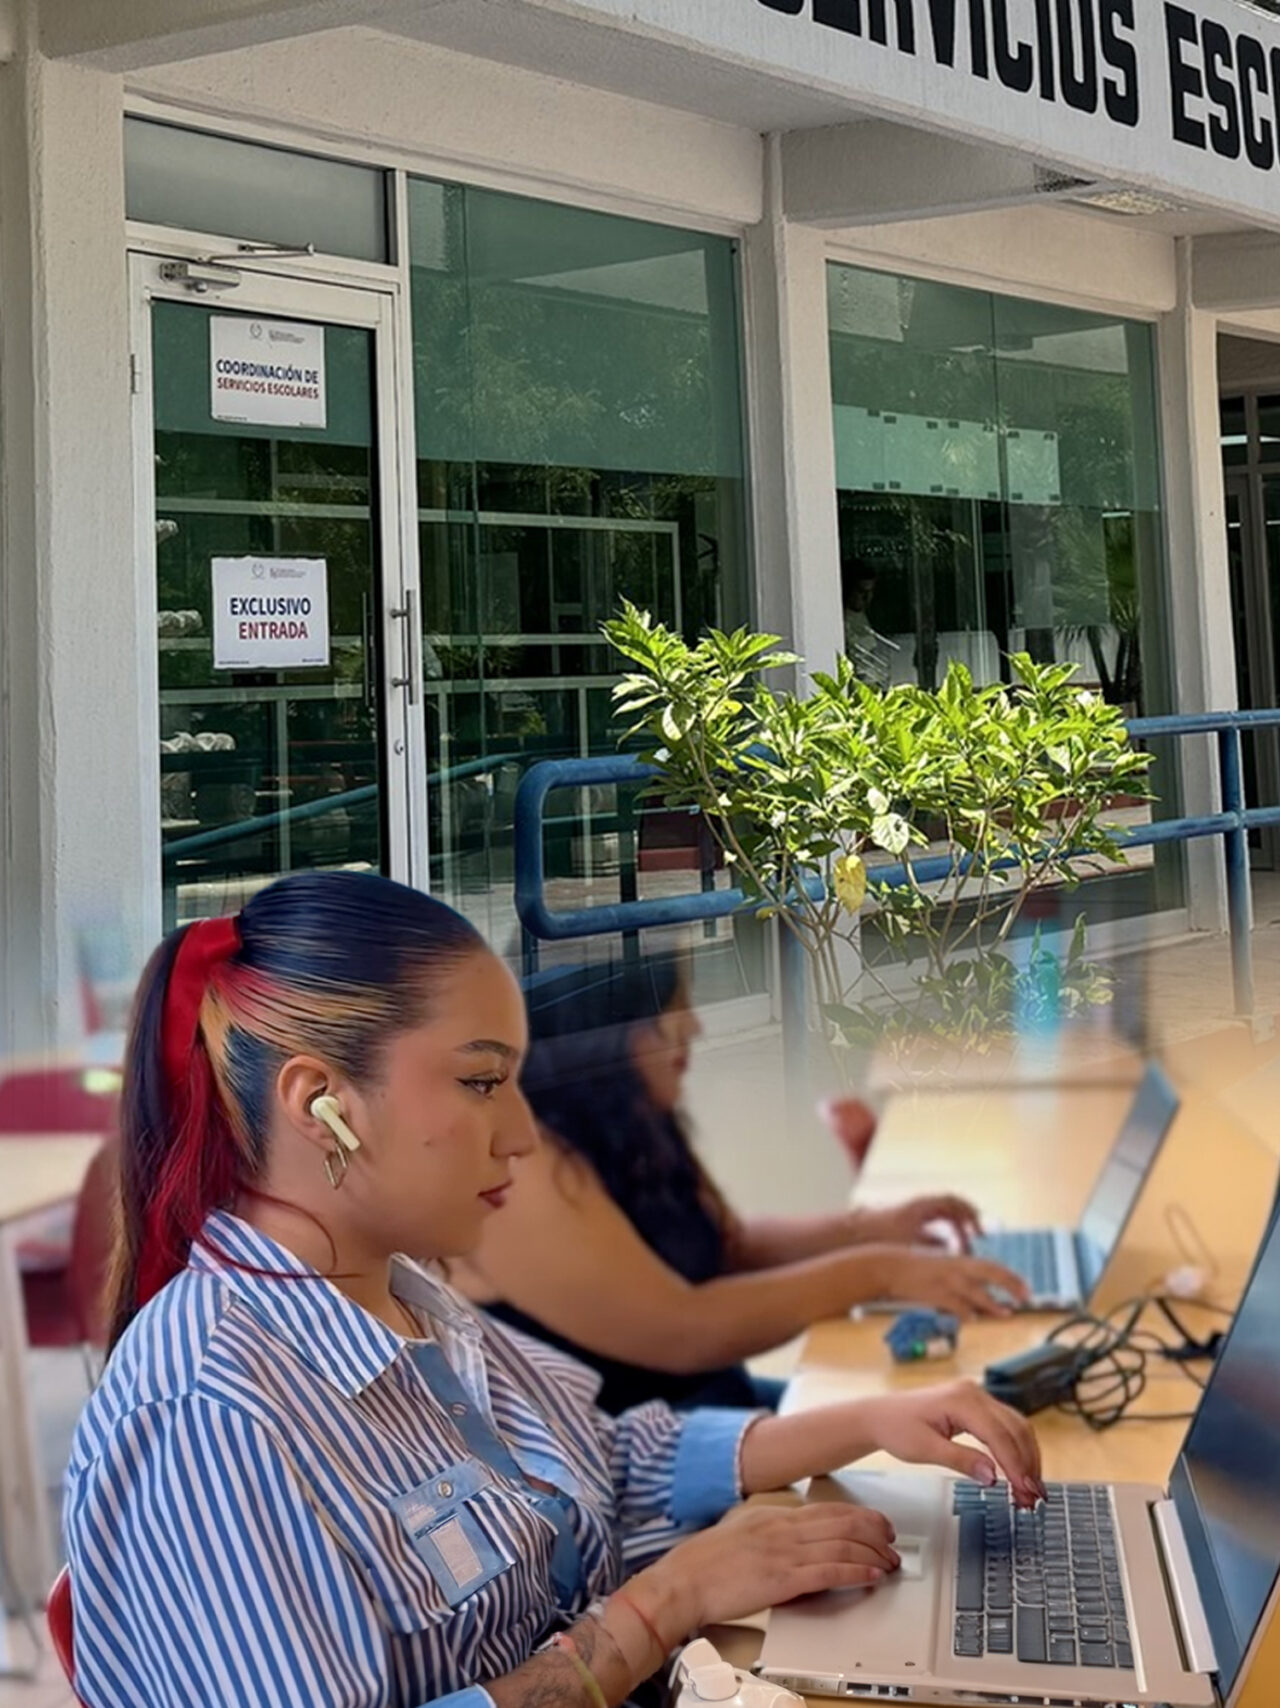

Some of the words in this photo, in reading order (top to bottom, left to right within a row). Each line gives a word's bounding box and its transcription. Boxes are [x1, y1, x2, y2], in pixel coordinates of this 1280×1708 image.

[758, 0, 1140, 127] ICIOS
[216, 359, 302, 381] COORDINACIÓN
[305, 370, 319, 384] DE
[217, 377, 265, 394] SERVICIOS
[267, 383, 319, 399] ESCOLARES
[230, 597, 311, 616] EXCLUSIVO
[239, 621, 308, 639] ENTRADA
